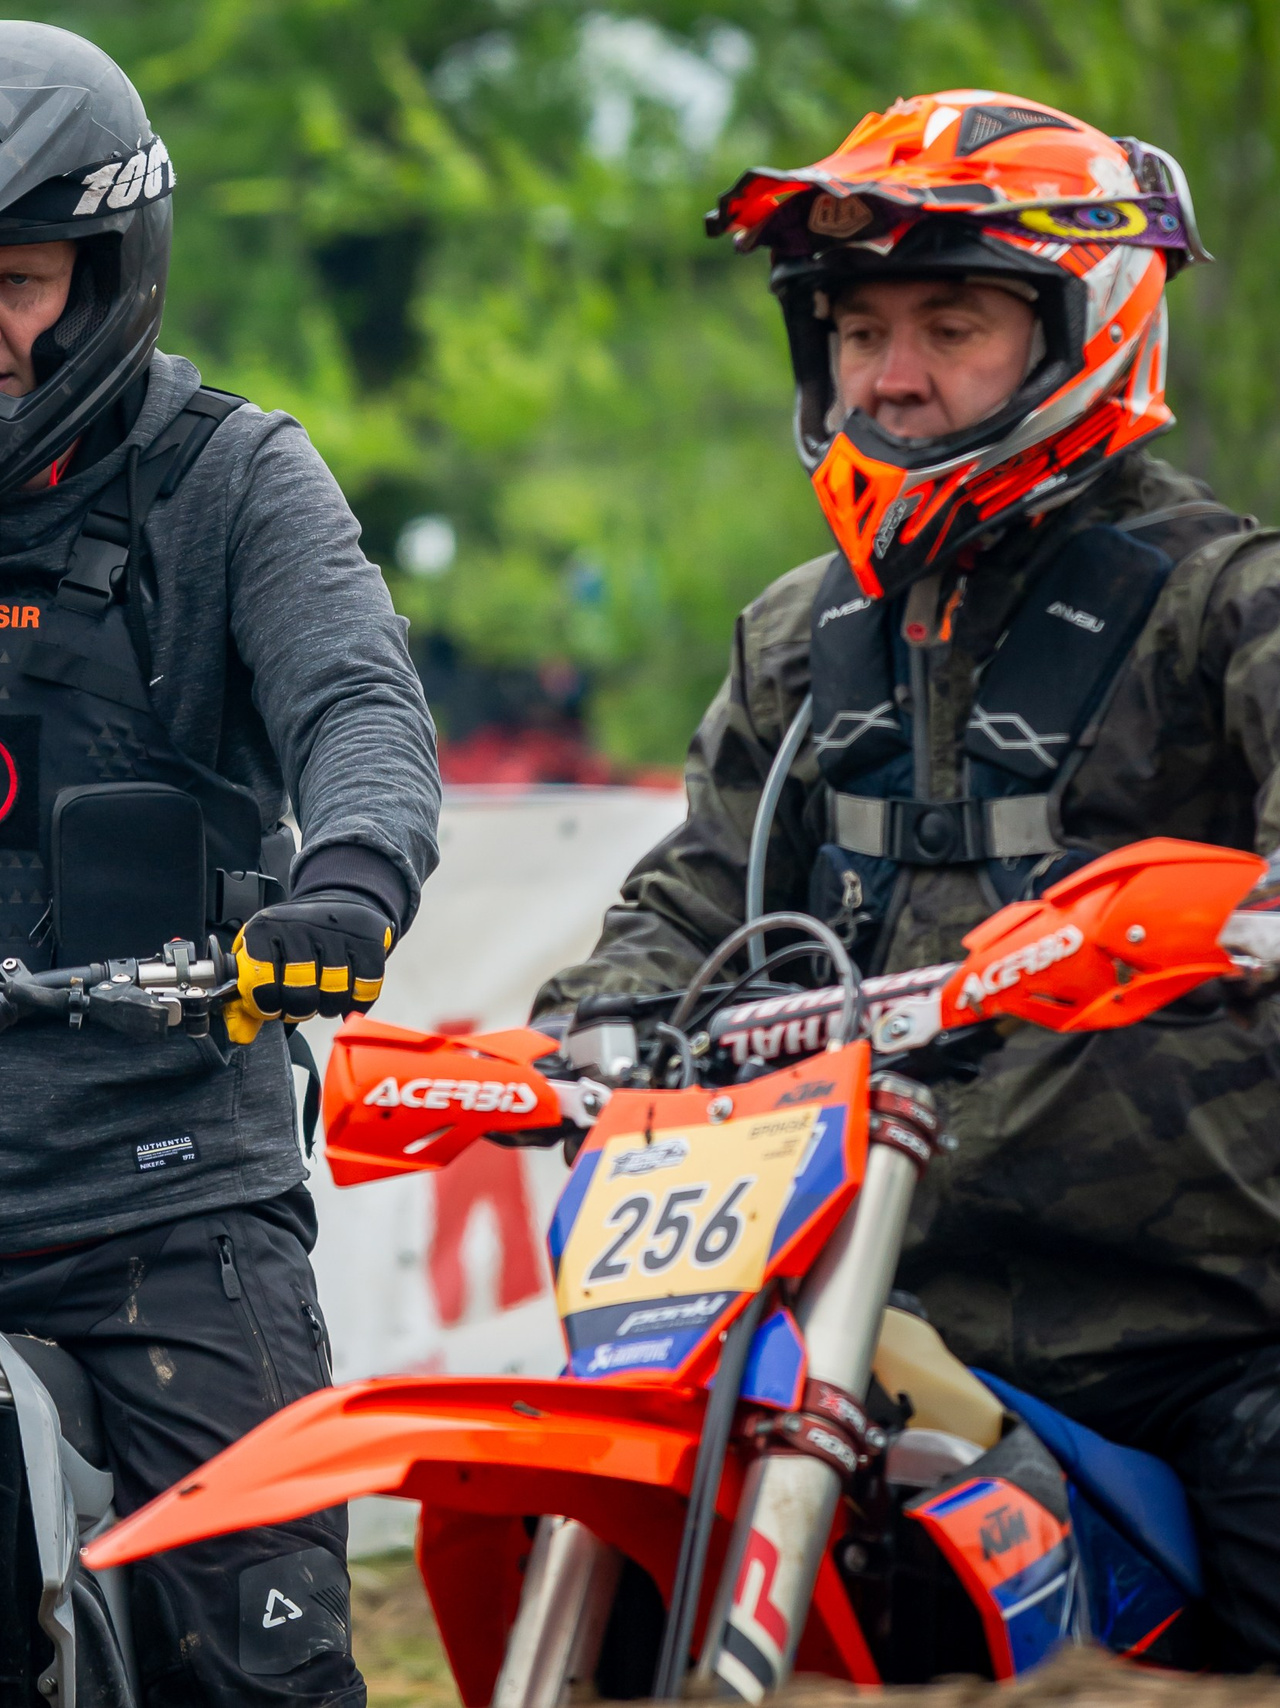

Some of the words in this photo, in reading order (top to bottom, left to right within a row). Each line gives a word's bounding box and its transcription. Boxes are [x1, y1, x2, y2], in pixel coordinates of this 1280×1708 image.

[363, 1076, 538, 1114] ACERBIS
[136, 1136, 191, 1152] AUTHENTIC
[585, 1177, 756, 1284] 256
[979, 1503, 1031, 1560] KTM
